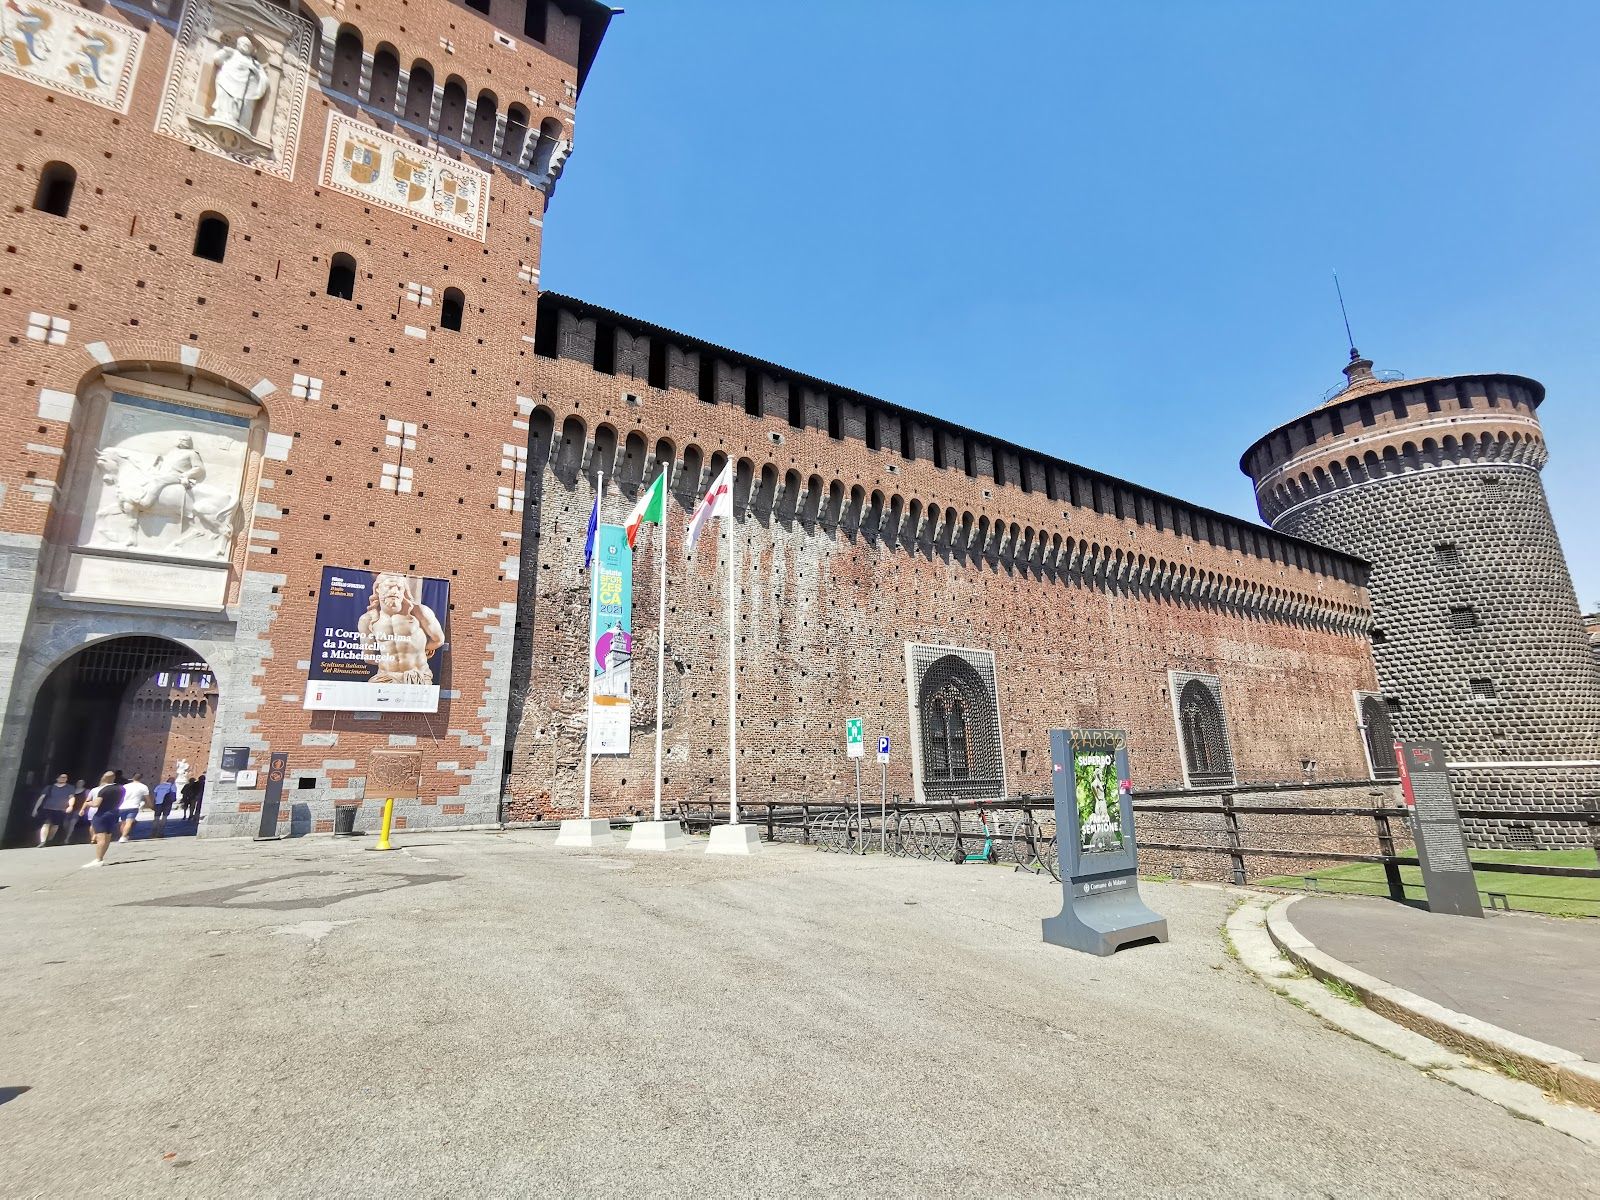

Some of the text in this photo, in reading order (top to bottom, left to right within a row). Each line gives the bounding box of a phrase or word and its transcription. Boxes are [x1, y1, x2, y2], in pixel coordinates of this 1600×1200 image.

[600, 575, 622, 584] SFOR
[600, 583, 622, 593] ZES
[600, 592, 622, 605] CA
[601, 604, 623, 614] 2021
[325, 628, 333, 636] Il
[335, 629, 366, 640] Corpo
[376, 631, 412, 641] l'Anima
[323, 639, 386, 651] da Donatello
[330, 650, 396, 663] Michelangelo
[880, 738, 888, 752] P
[1088, 814, 1110, 824] PARCO
[1082, 821, 1119, 835] SEMPIONE
[1091, 883, 1107, 891] Comune
